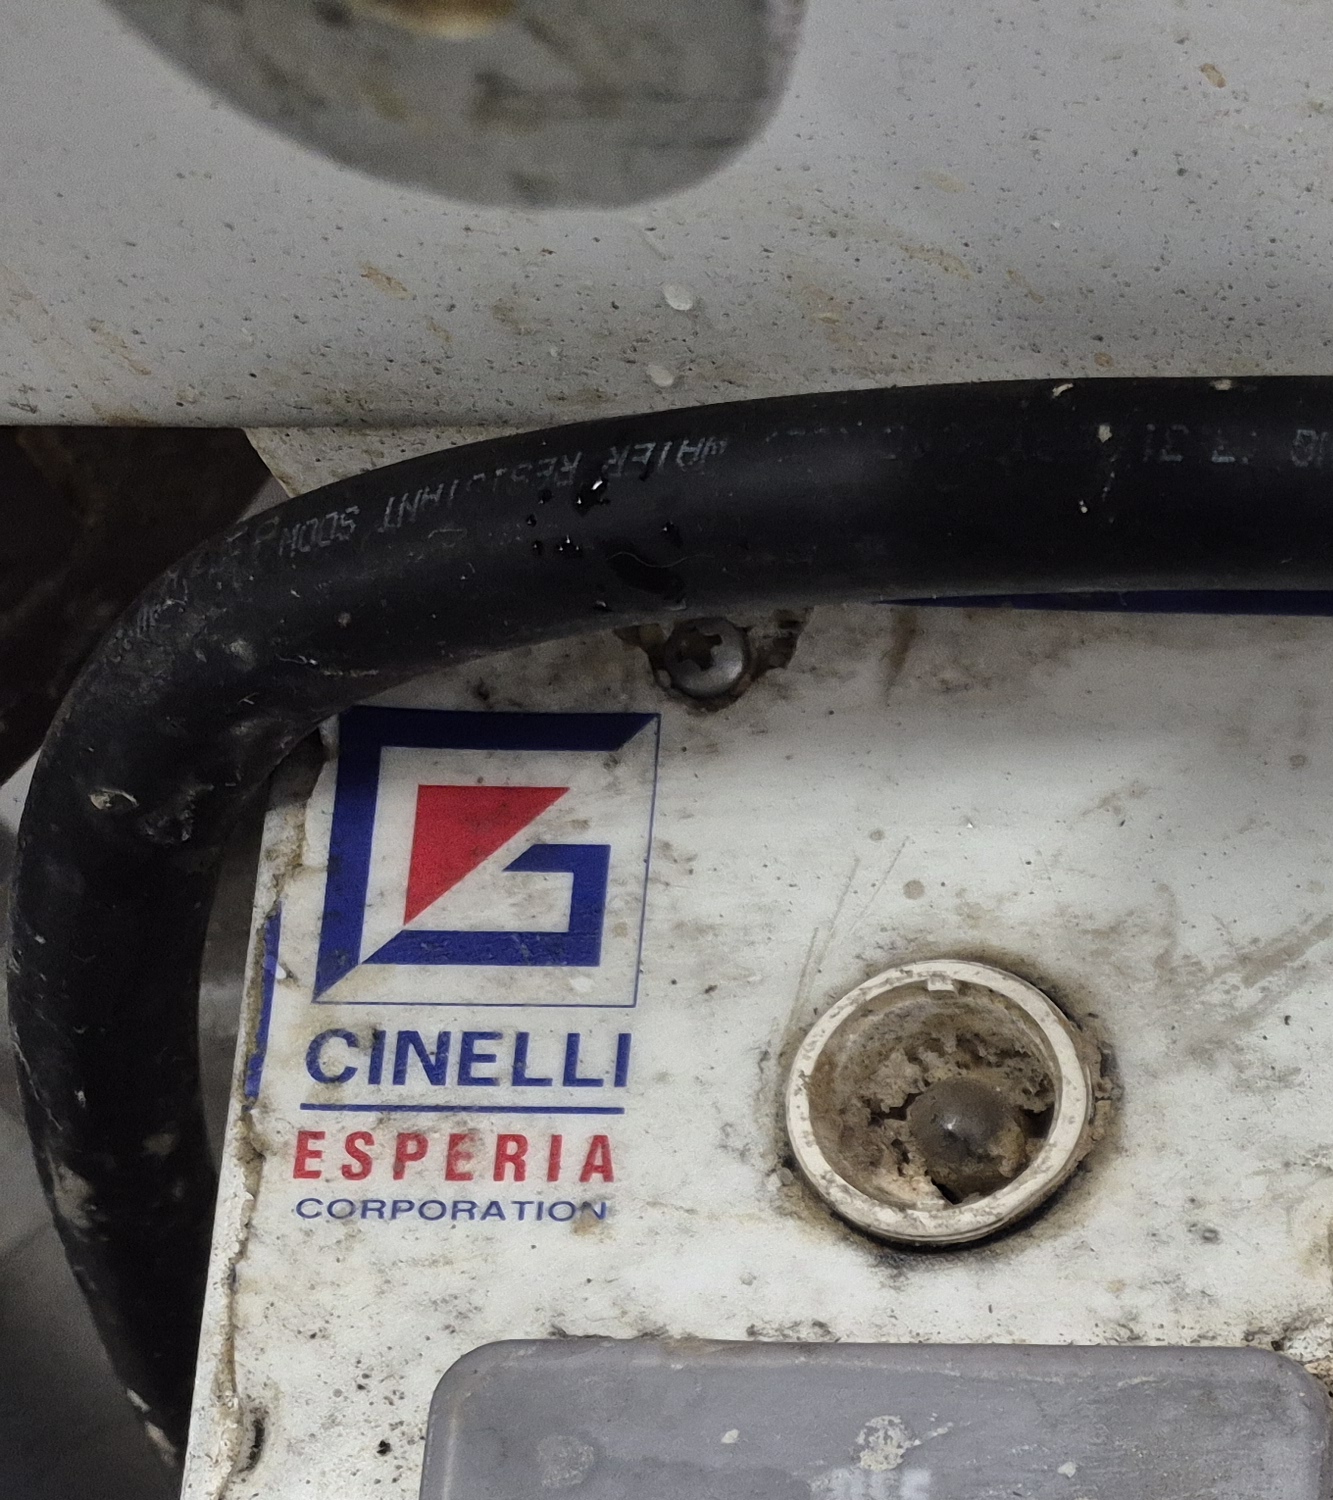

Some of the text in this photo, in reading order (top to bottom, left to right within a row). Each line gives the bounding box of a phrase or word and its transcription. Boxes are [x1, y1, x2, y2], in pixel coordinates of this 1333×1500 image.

[305, 1028, 632, 1088] CINELLI
[292, 1130, 615, 1183] ESPERIA
[295, 1197, 608, 1222] CORPORATION
